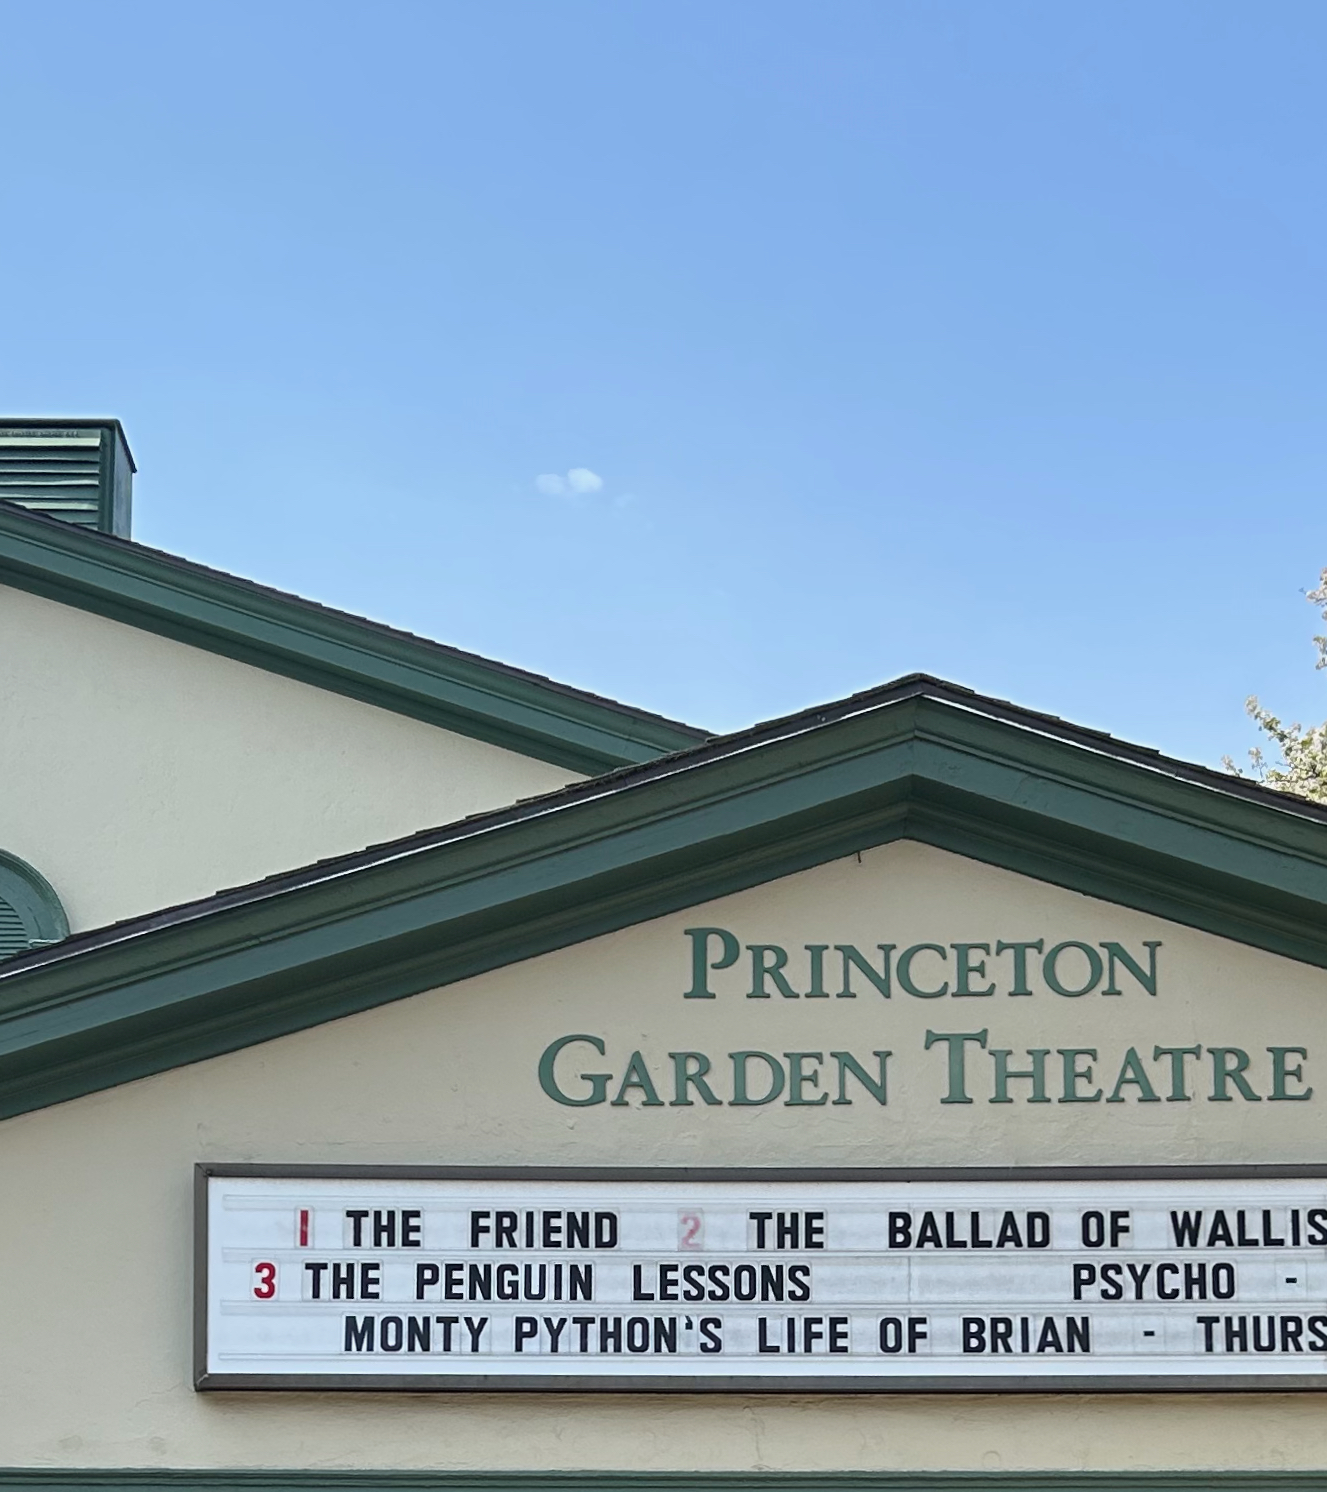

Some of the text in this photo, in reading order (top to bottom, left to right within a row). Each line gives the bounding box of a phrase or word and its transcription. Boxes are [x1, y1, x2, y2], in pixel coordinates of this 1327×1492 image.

[683, 926, 1162, 999] PRINCETON
[538, 1027, 1313, 1107] GARDEN THEATRE
[345, 1210, 422, 1249] THE
[470, 1211, 619, 1249] FRIEND
[680, 1211, 702, 1249] 2
[749, 1211, 825, 1249] THE
[887, 1210, 1051, 1249] BALLAD
[1081, 1210, 1130, 1248] OF
[254, 1262, 276, 1299] 3
[304, 1263, 381, 1300] THE
[415, 1263, 593, 1301] PENGUIN
[632, 1263, 811, 1302] LESSONS
[1073, 1262, 1237, 1301] PSYCHO
[344, 1316, 488, 1353] MONTY
[514, 1315, 722, 1354] PYTHON'S
[758, 1316, 849, 1354] LIFE
[879, 1316, 928, 1354] OF
[961, 1316, 1092, 1354] BRIAN
